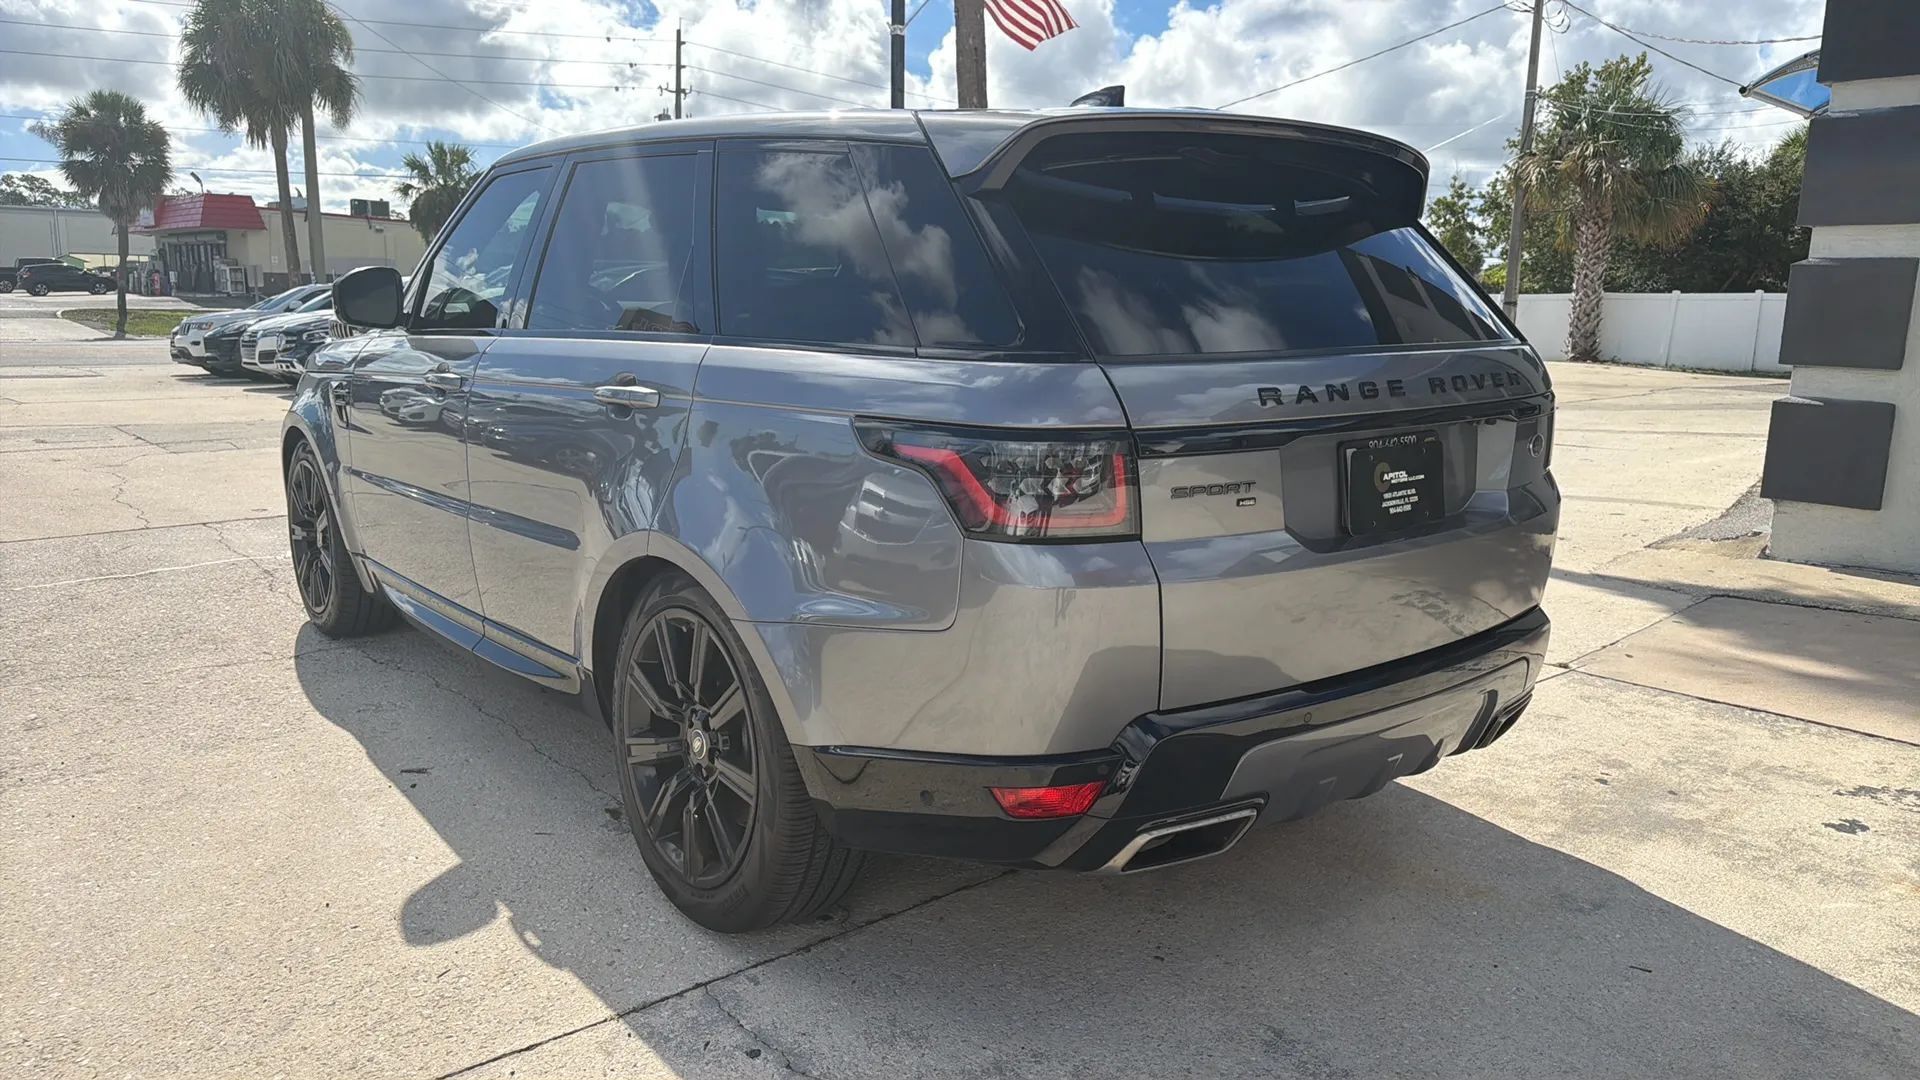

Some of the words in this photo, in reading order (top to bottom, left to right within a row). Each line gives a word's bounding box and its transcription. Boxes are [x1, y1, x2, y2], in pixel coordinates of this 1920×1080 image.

[1257, 379, 1407, 407] RANGE
[1428, 371, 1521, 395] ROVER
[1170, 481, 1256, 499] SPORT
